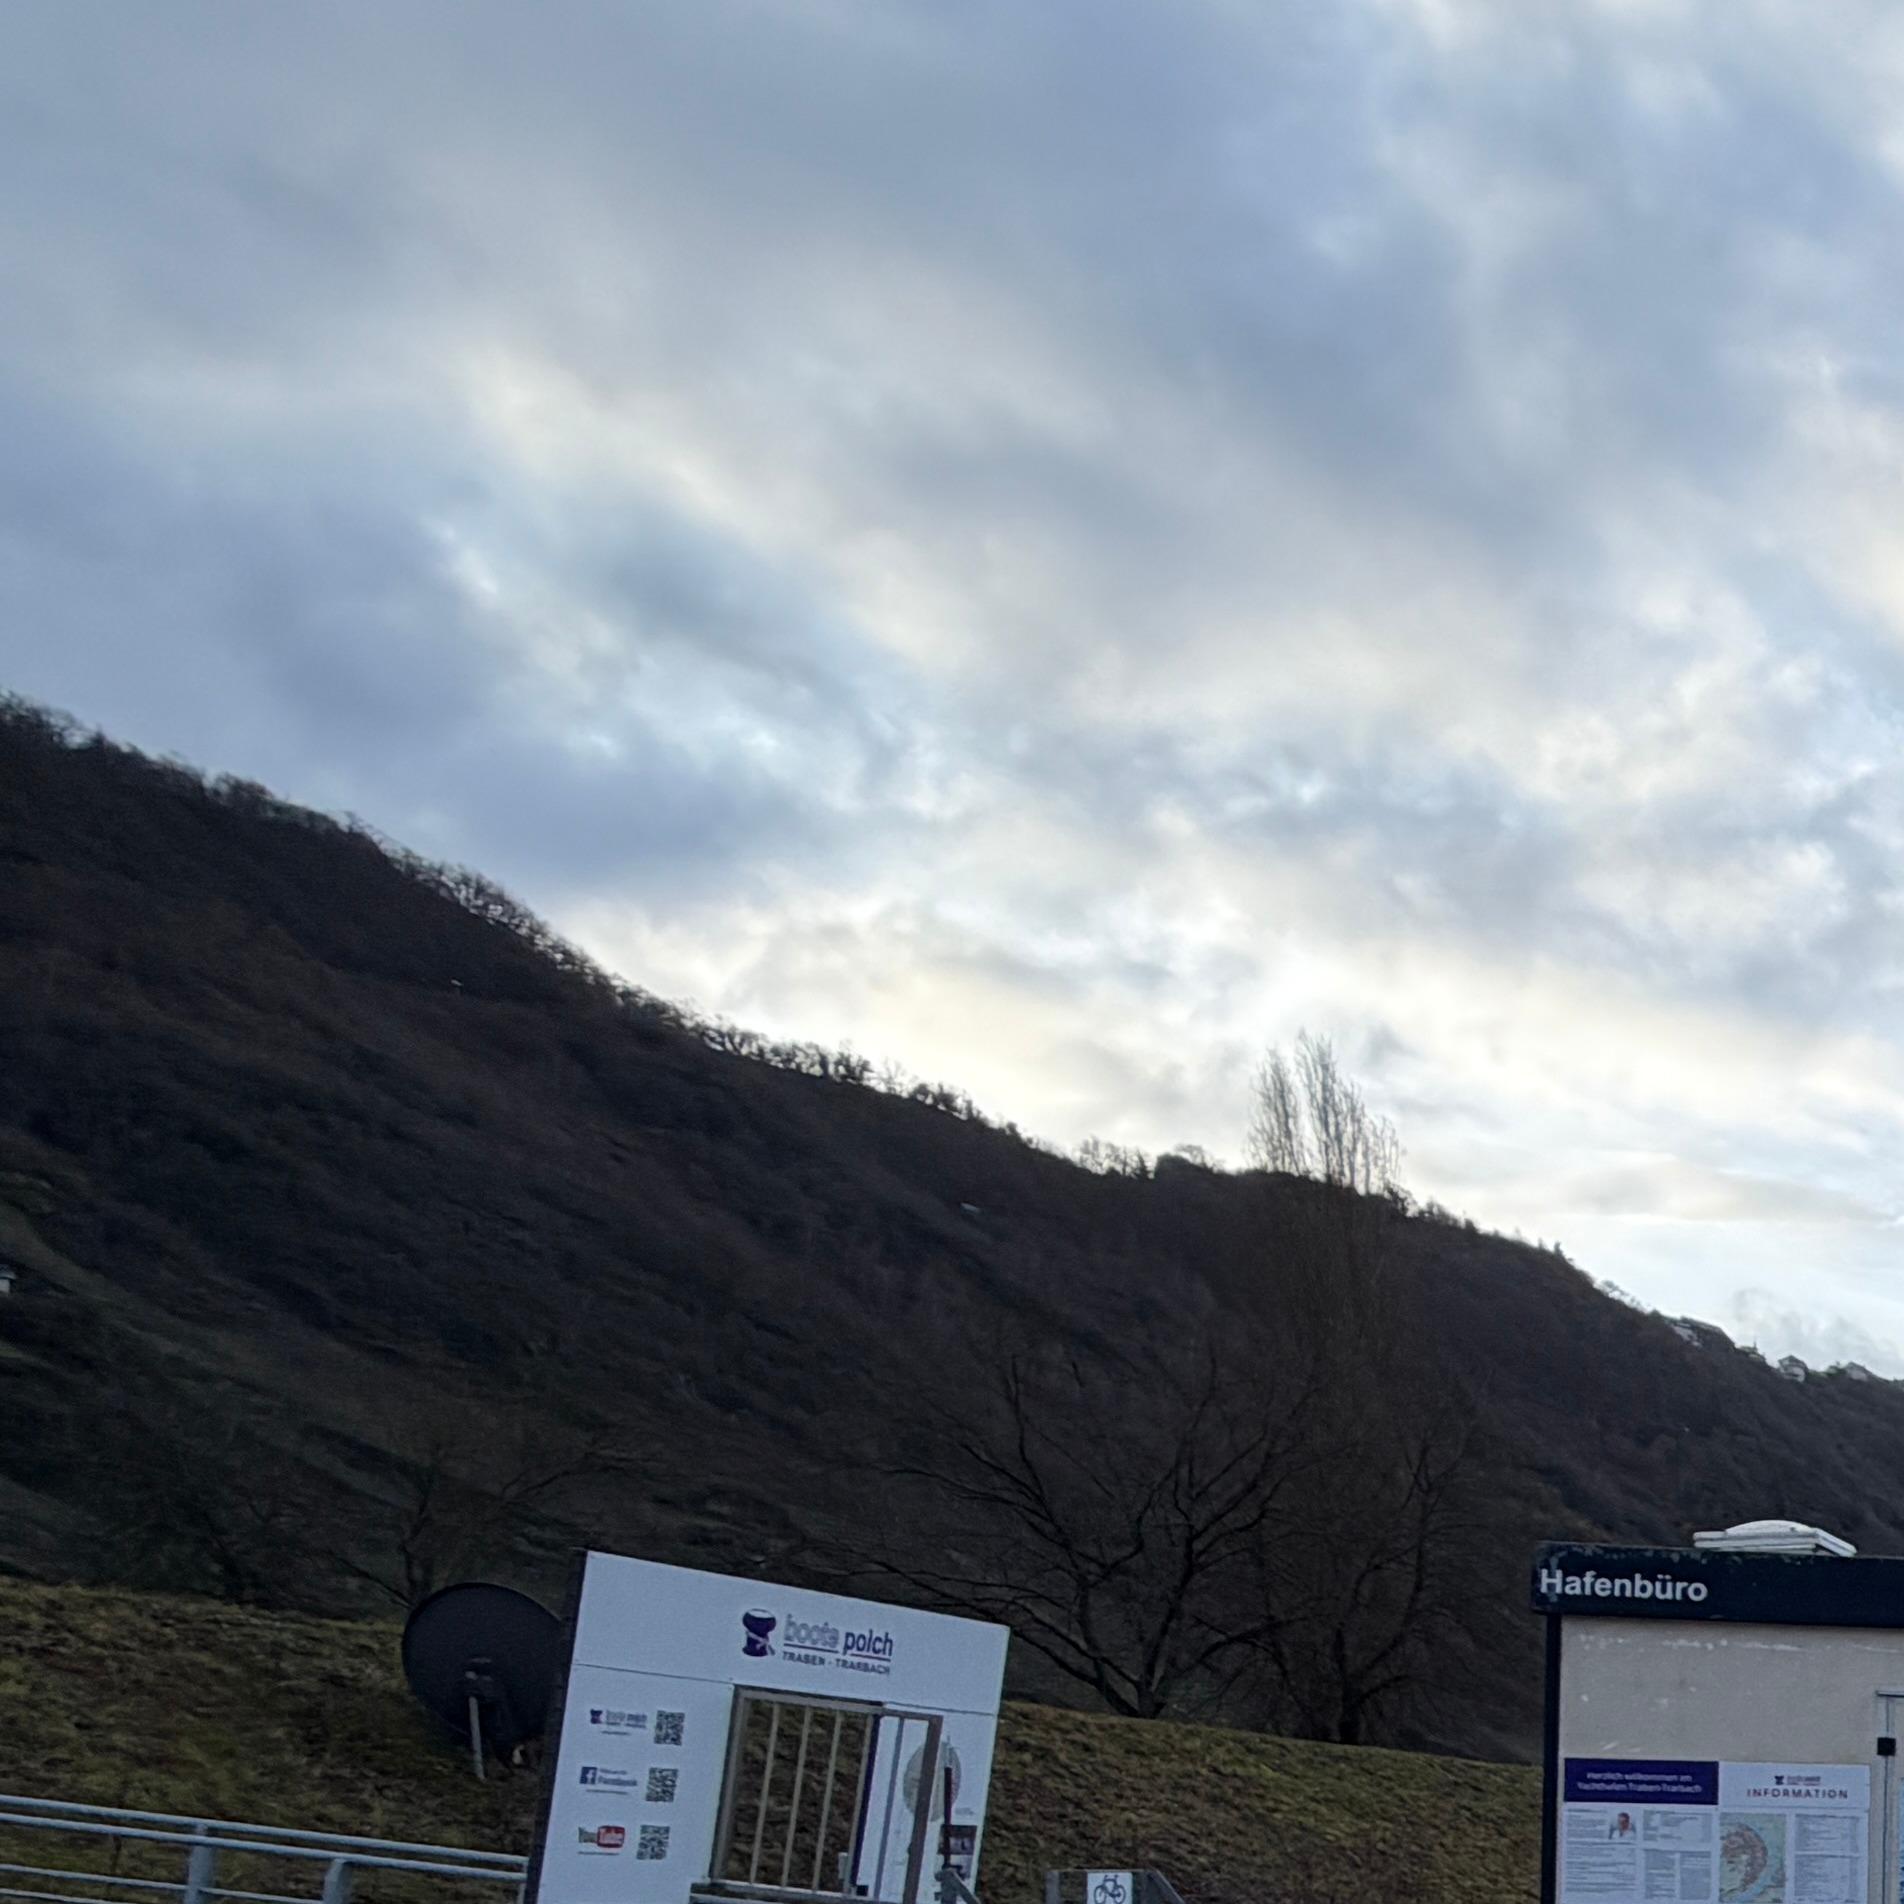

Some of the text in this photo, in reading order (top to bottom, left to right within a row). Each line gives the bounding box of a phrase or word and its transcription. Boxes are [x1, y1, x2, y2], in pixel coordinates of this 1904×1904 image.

[1540, 1568, 1708, 1602] Hafenbüro
[842, 1628, 894, 1657] polch
[1746, 1787, 1849, 1800] INFORMATION
